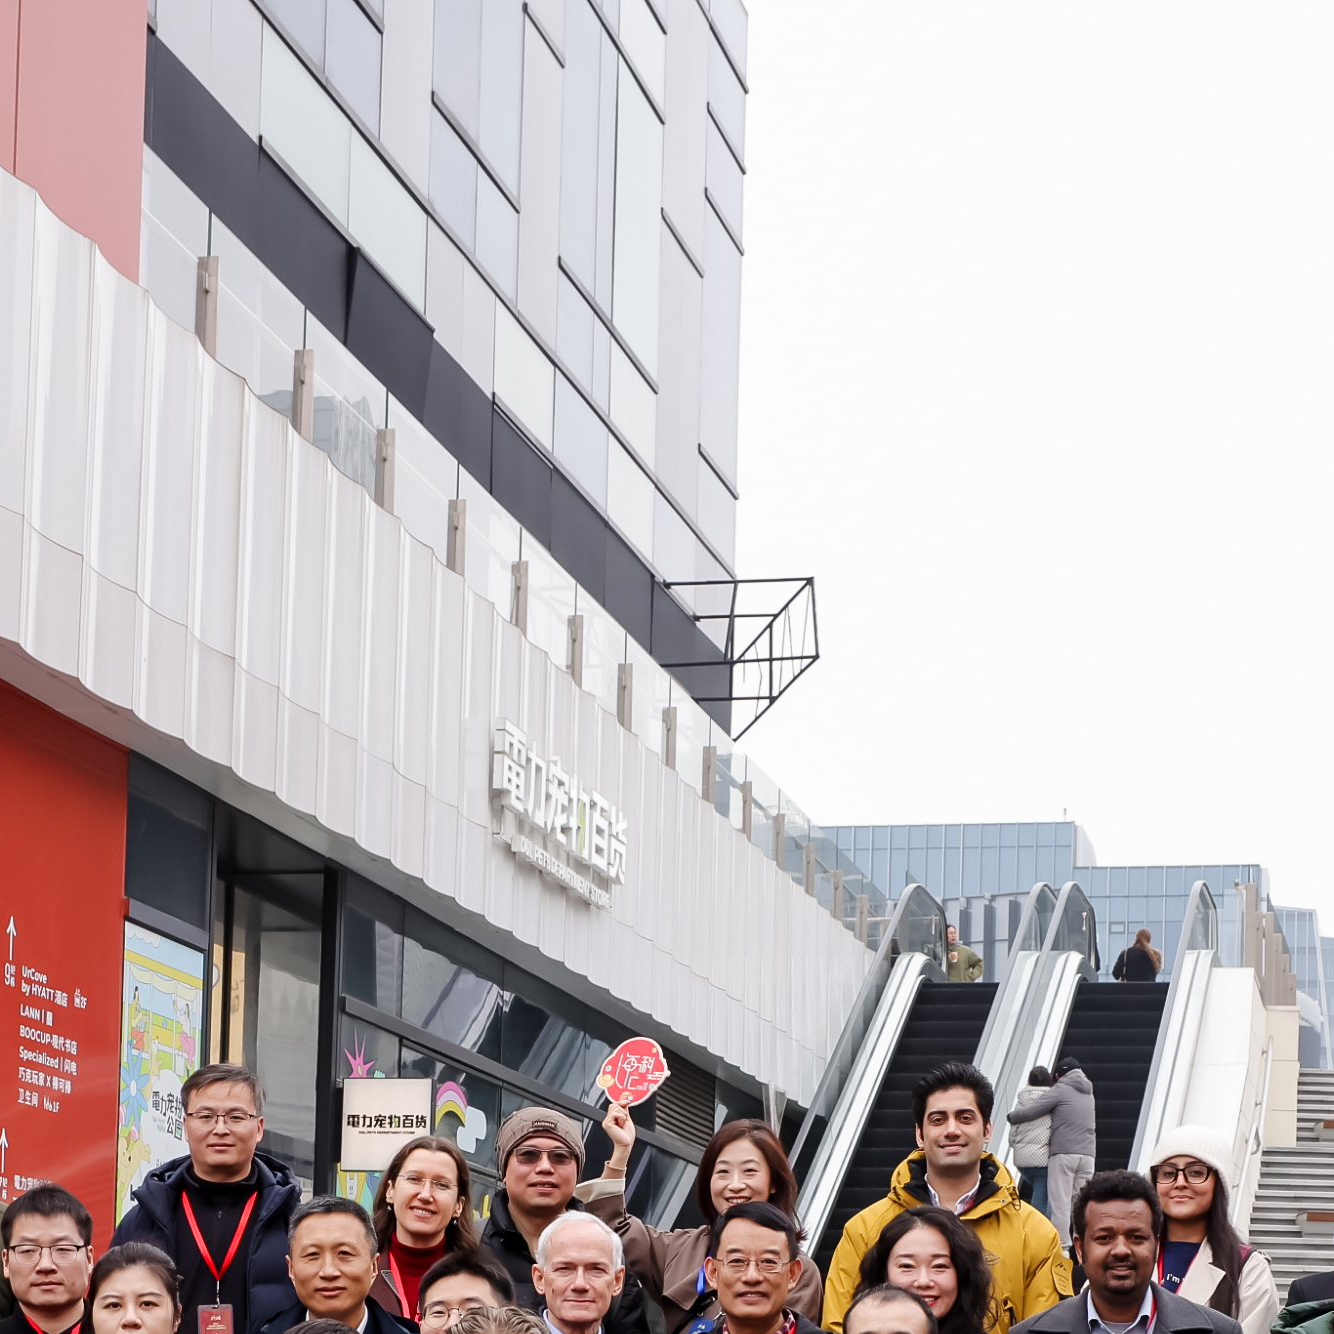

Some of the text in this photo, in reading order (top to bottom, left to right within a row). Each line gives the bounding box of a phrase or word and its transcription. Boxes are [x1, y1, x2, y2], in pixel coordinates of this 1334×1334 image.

[551, 856, 590, 899] DEPARTMENT
[21, 965, 47, 984] UrCove
[21, 979, 31, 997] by
[31, 983, 54, 1002] HYATT
[20, 1003, 41, 1021] LANN
[19, 1045, 77, 1076] Specialized 闪电
[17, 1087, 39, 1108] 卫生间
[347, 1114, 427, 1129] 電力宠物百货
[1167, 1273, 1180, 1284] I'm
